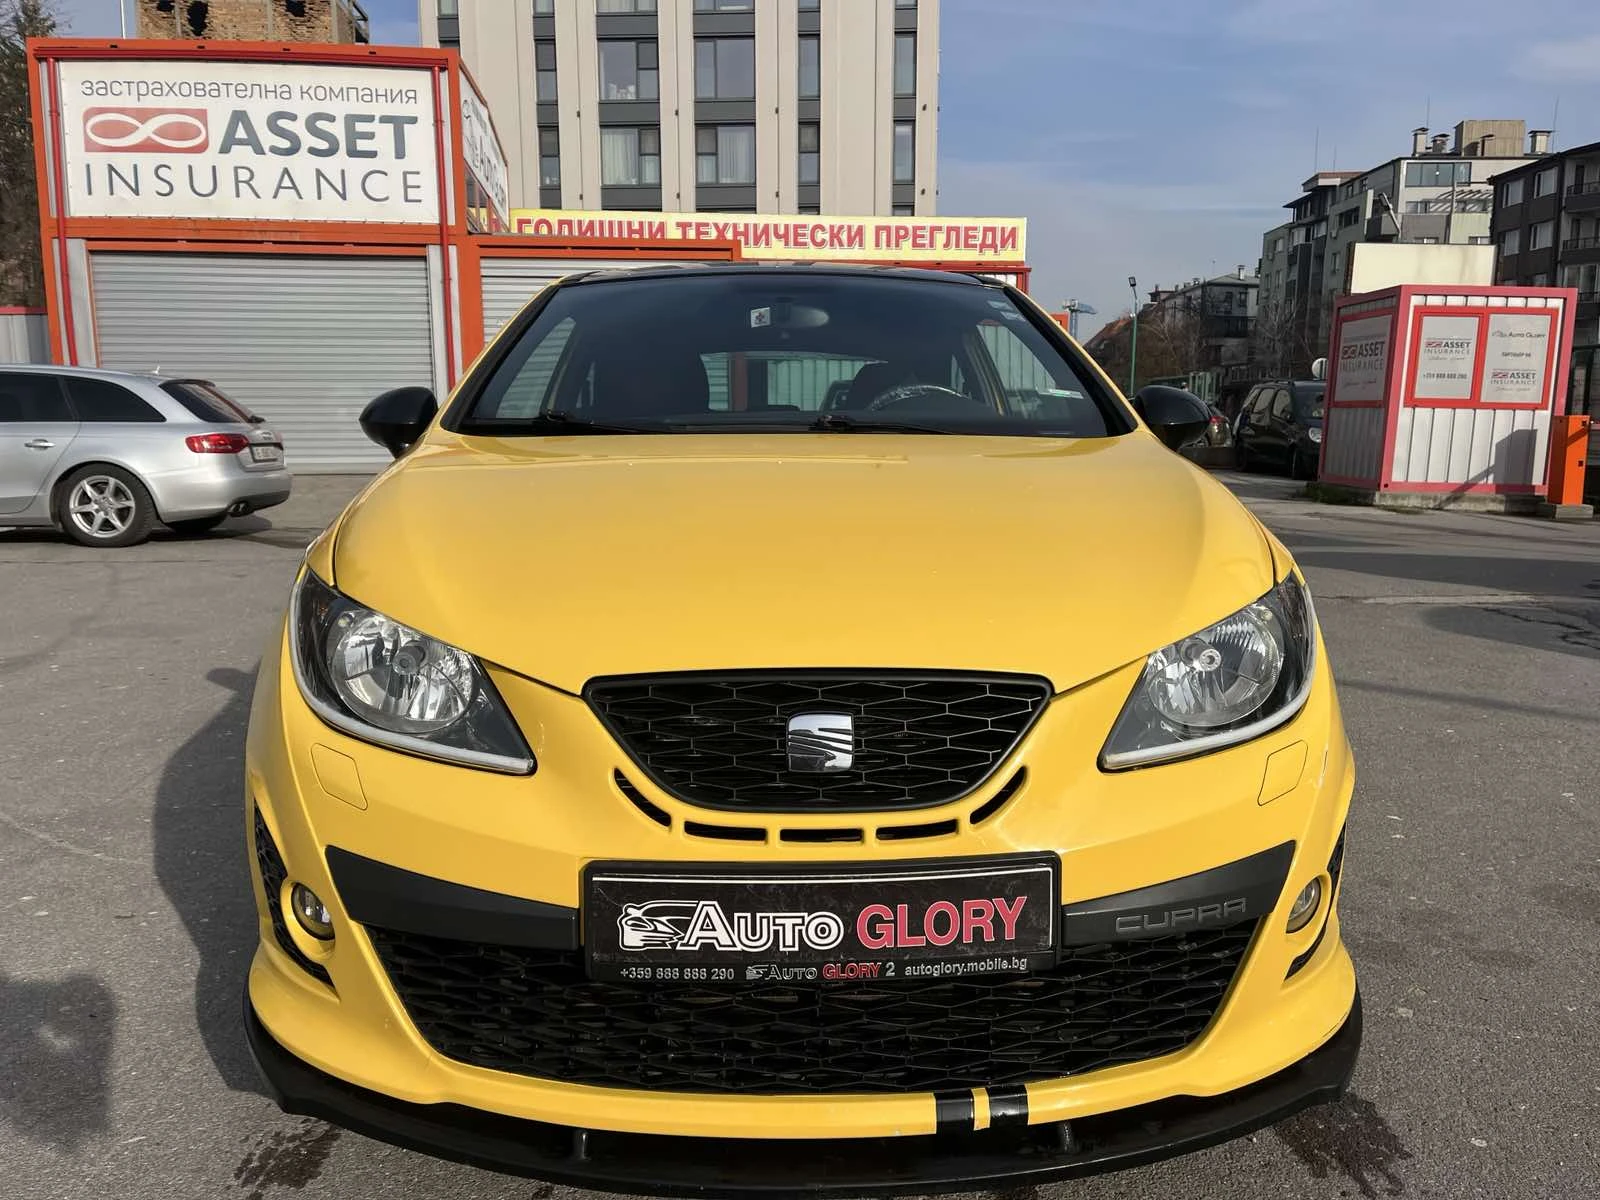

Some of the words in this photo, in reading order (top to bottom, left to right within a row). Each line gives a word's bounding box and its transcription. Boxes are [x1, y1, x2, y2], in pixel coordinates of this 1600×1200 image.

[81, 79, 292, 102] застрахователна
[299, 86, 418, 105] компания
[218, 110, 418, 160] ASSET
[85, 163, 422, 203] INSURANCE
[675, 221, 865, 248] ТЕХНИЧЕСКИ
[874, 225, 1018, 255] ПРЕГЛЕДИ
[1358, 341, 1385, 358] ASSET
[1443, 341, 1472, 349] ASSET
[1510, 372, 1536, 380] ASSET
[856, 896, 1027, 950] GLORY
[1115, 897, 1247, 933] CUPRA
[620, 967, 651, 980] +359
[656, 967, 680, 980] 888
[684, 967, 707, 980] 888
[710, 967, 735, 980] 290
[822, 962, 882, 980] GLORY
[885, 961, 896, 977] 2
[904, 957, 1028, 976] autoglory.mobile.bg
